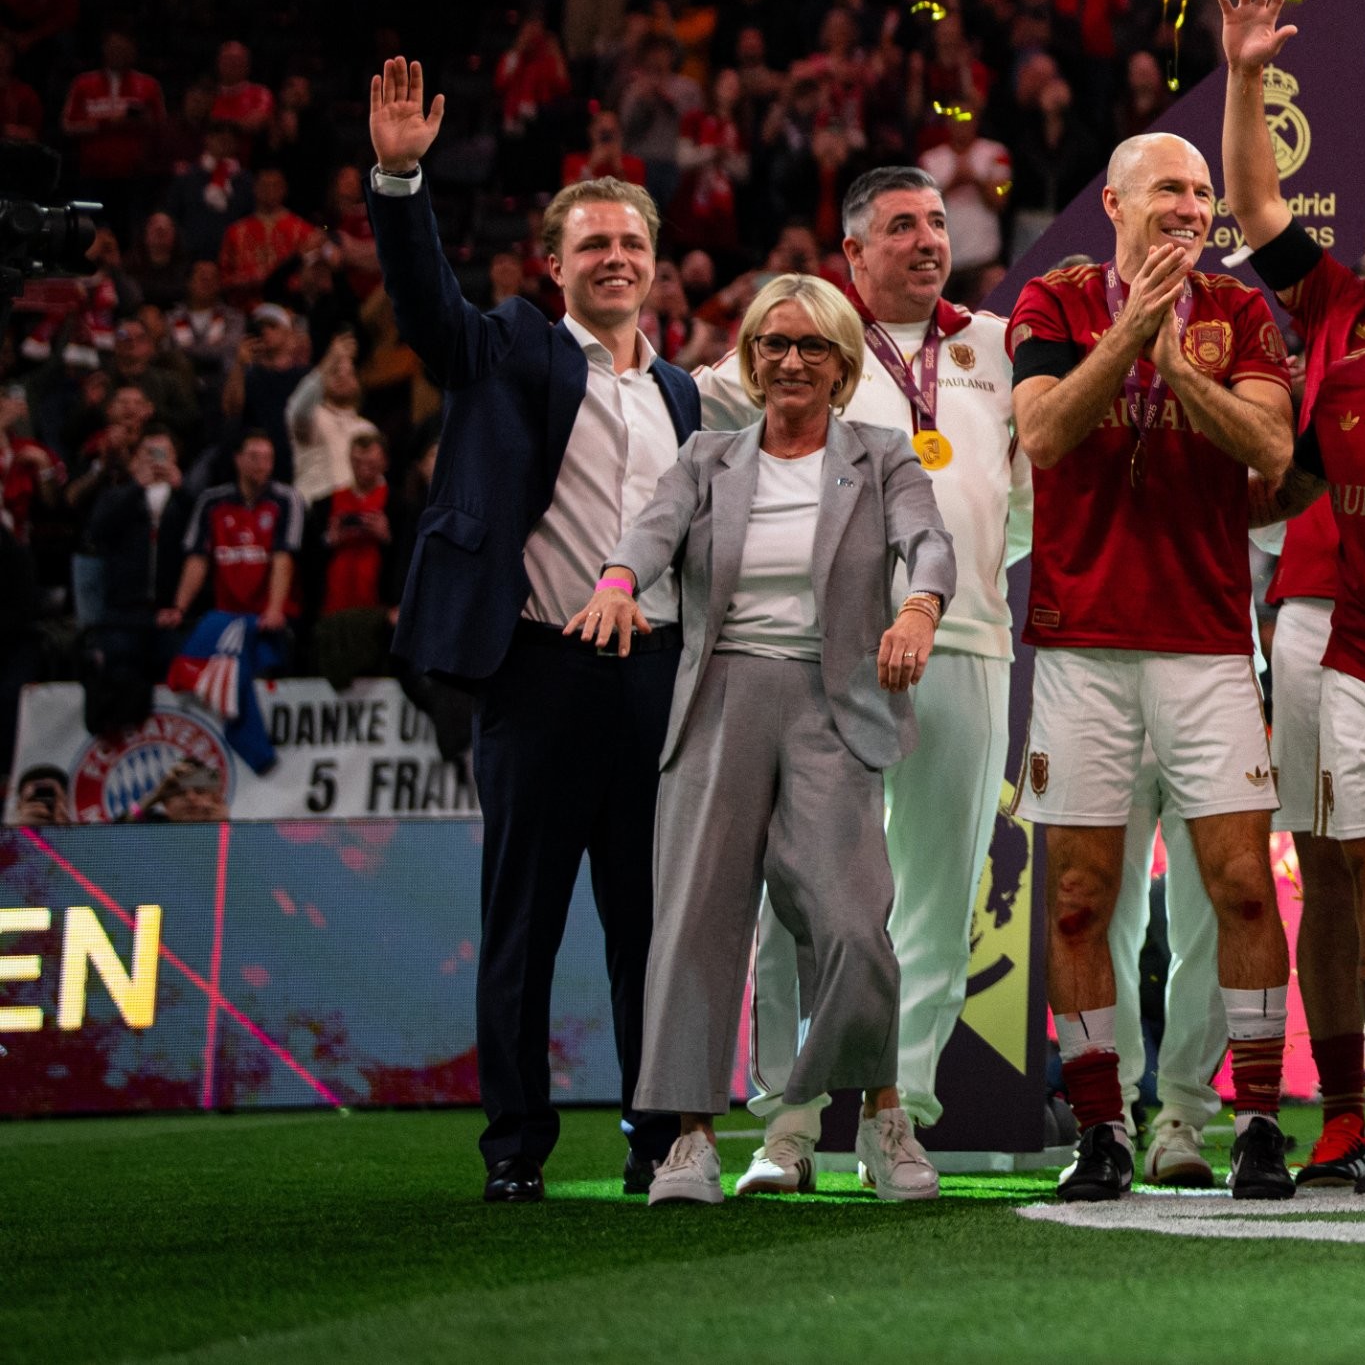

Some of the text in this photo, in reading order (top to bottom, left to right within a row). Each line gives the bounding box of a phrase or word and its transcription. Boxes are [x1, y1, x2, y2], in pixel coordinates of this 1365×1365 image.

[1286, 192, 1336, 217] drid
[937, 375, 996, 393] PAULANER
[270, 701, 388, 746] DANKE
[307, 759, 337, 812] 5
